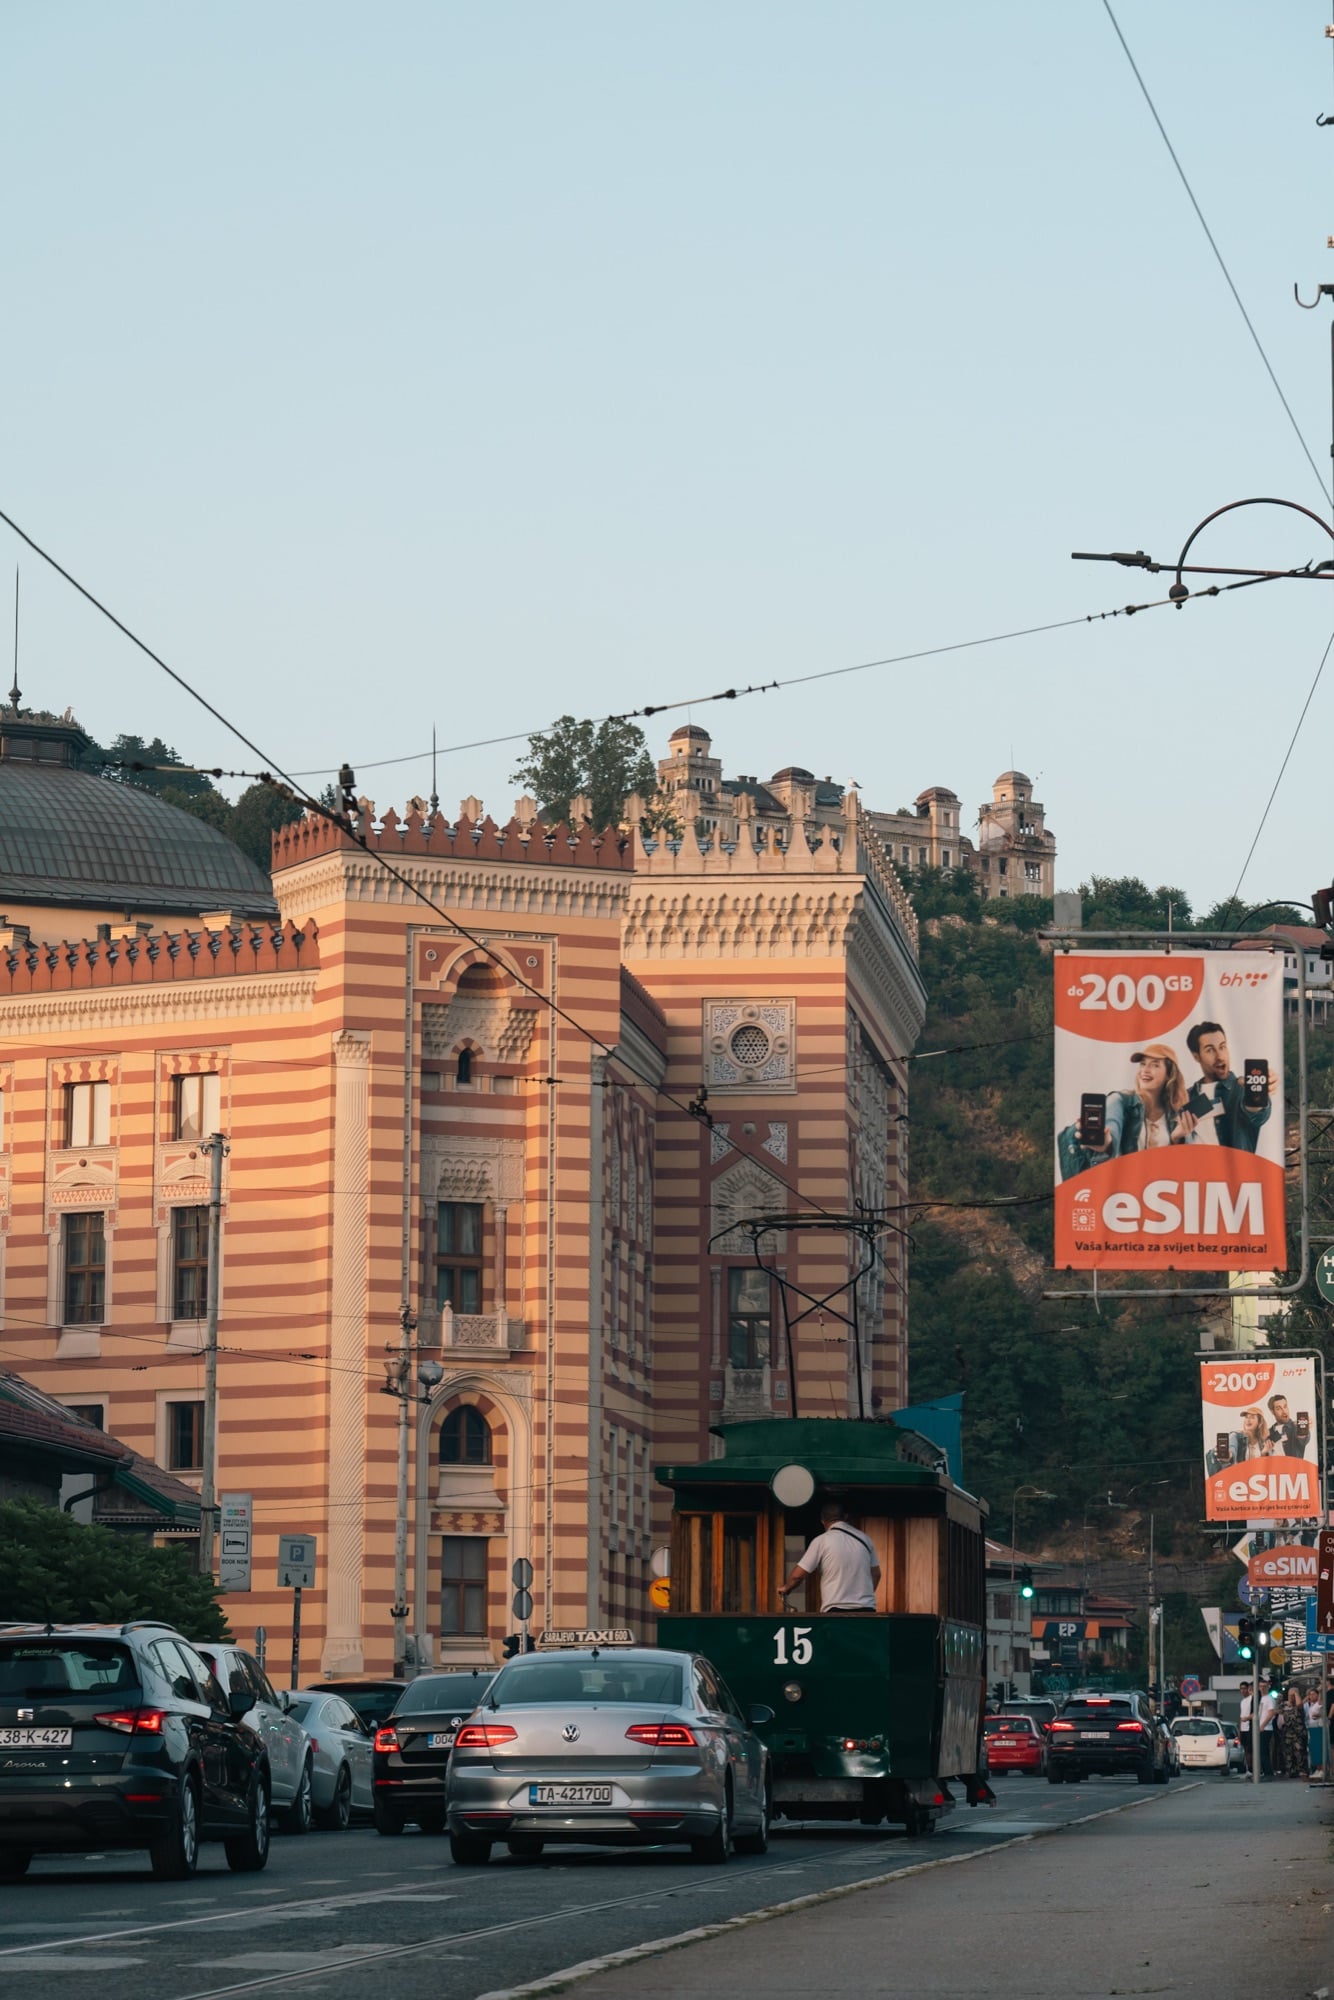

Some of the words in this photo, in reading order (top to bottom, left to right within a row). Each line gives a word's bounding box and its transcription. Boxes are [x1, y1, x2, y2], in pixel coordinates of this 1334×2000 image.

[1067, 985, 1084, 997] do
[1079, 974, 1166, 1011] 200
[1165, 975, 1193, 991] GB
[1246, 1075, 1267, 1084] 200
[1102, 1180, 1265, 1235] eSIM
[1075, 1241, 1101, 1251] Vaša
[1104, 1241, 1144, 1252] kartica
[1147, 1244, 1161, 1252] za
[1163, 1242, 1195, 1255] svijet
[1197, 1242, 1218, 1253] bez
[1220, 1243, 1267, 1256] granica!
[1214, 1373, 1257, 1392] 200
[1255, 1372, 1270, 1381] GB
[1229, 1473, 1309, 1502] eSIM
[1263, 1557, 1317, 1575] eSIM
[544, 1632, 575, 1642] SARAJEVO
[576, 1631, 614, 1642] TAXI
[615, 1630, 628, 1641] 600
[773, 1627, 813, 1665] 15
[538, 1787, 610, 1801] TA-421700
